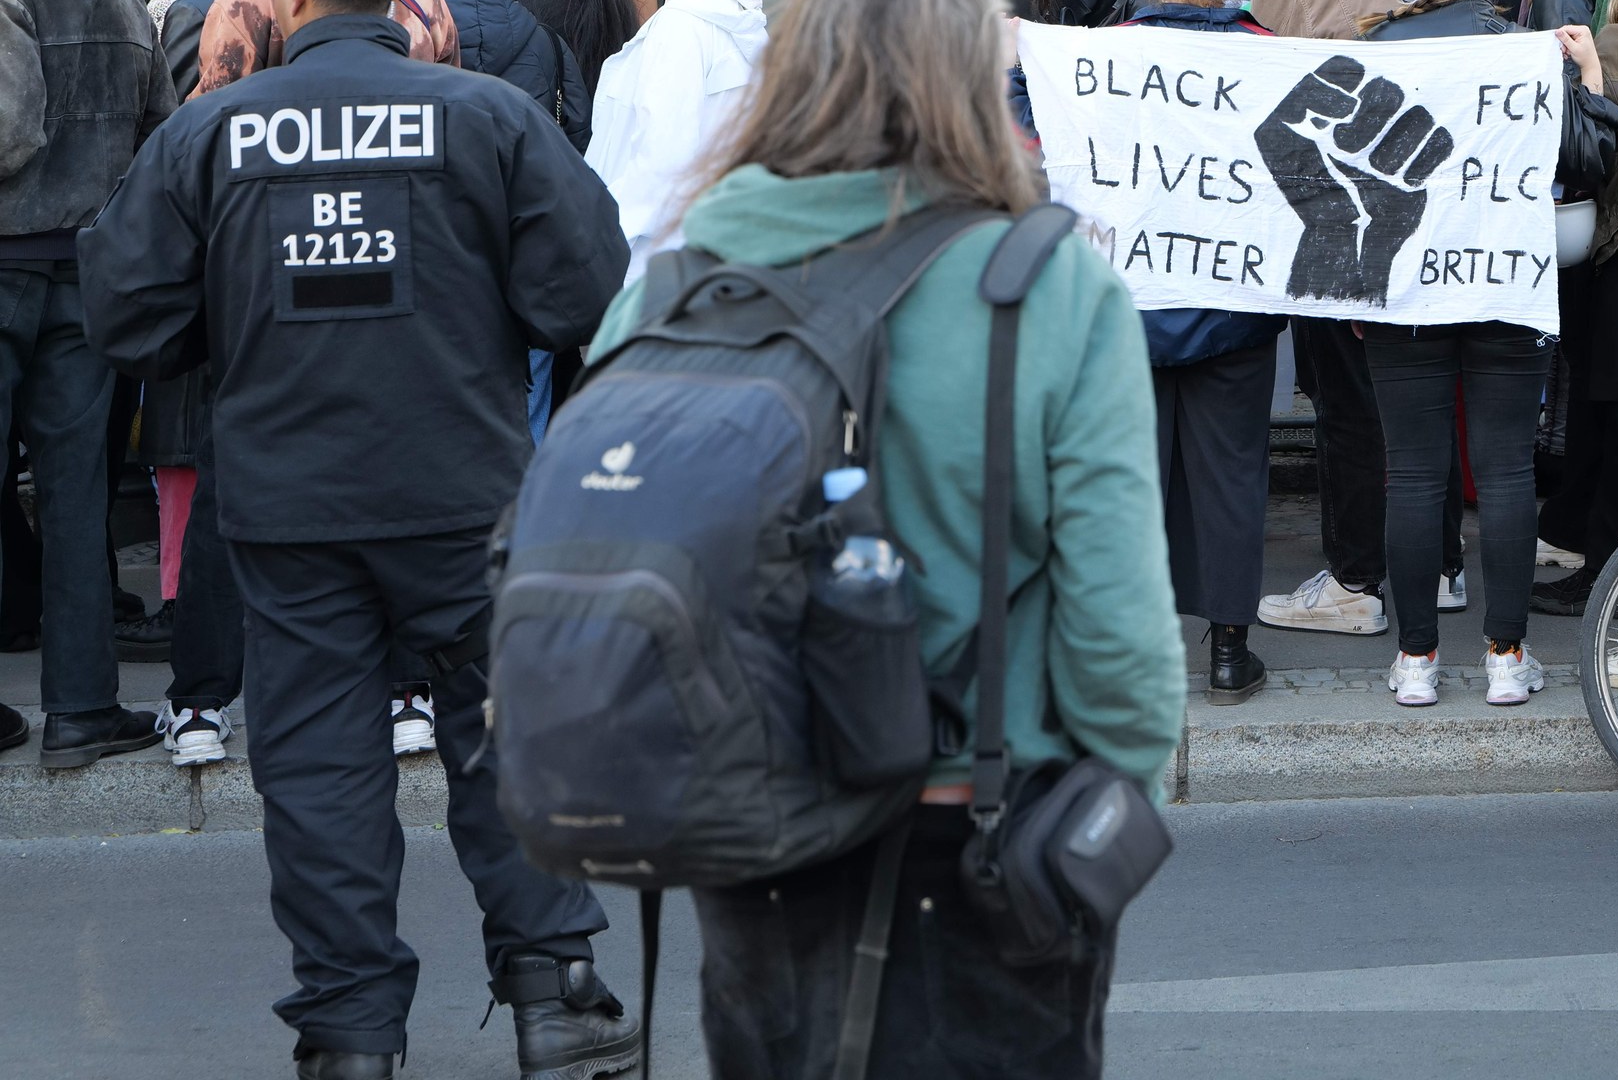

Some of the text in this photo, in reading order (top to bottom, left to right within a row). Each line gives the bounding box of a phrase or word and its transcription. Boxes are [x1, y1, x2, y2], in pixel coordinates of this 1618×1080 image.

[1075, 58, 1242, 112] BLACK
[1476, 80, 1553, 125] FCK
[230, 104, 434, 170] POLIZEI
[1088, 136, 1253, 204] LIVES
[1461, 157, 1538, 202] PLC
[313, 191, 363, 227] BE
[282, 229, 397, 267] 12123
[1421, 248, 1552, 290] BRTLTY
